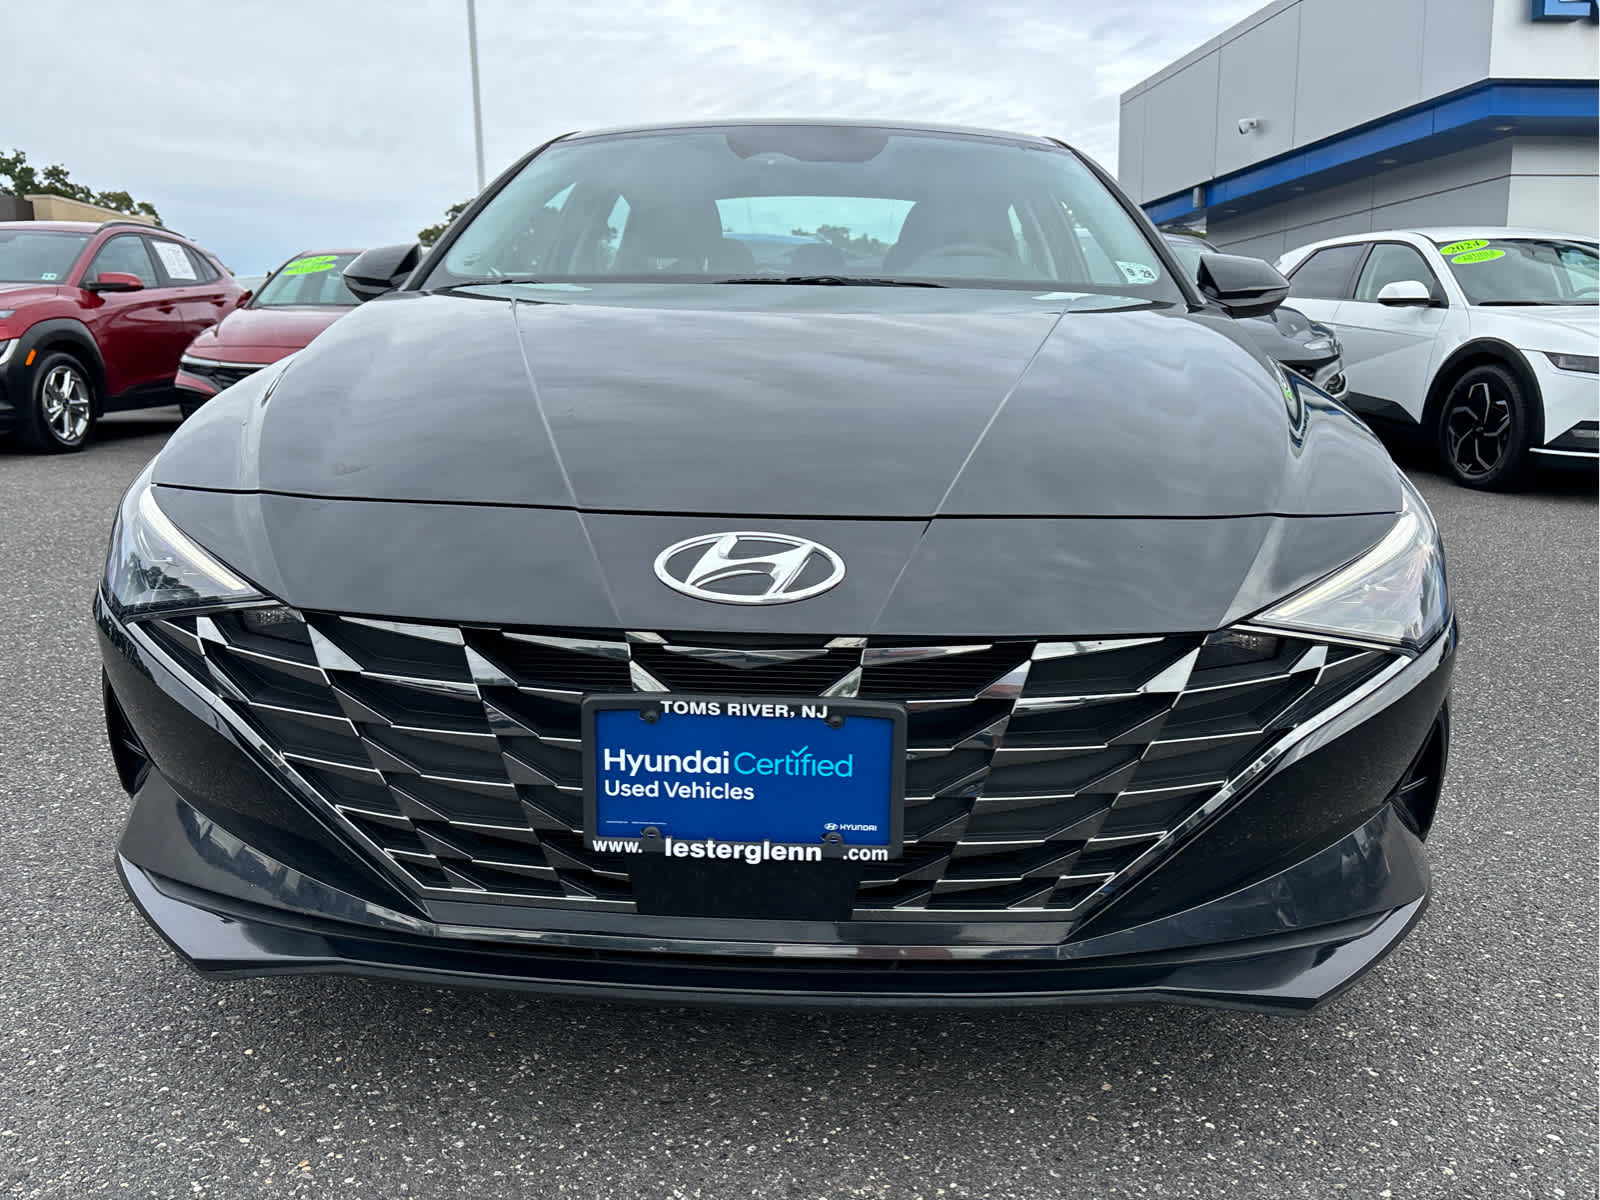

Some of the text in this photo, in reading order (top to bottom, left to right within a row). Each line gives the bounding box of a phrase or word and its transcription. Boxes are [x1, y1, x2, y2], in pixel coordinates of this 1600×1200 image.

[660, 700, 828, 719] TOMS RIVER, NJ
[604, 746, 853, 777] Hyundai Certified
[604, 779, 755, 800] Used Vehicles
[840, 823, 878, 832] HYUNDAI
[592, 837, 889, 865] www. lesterglenn .com
